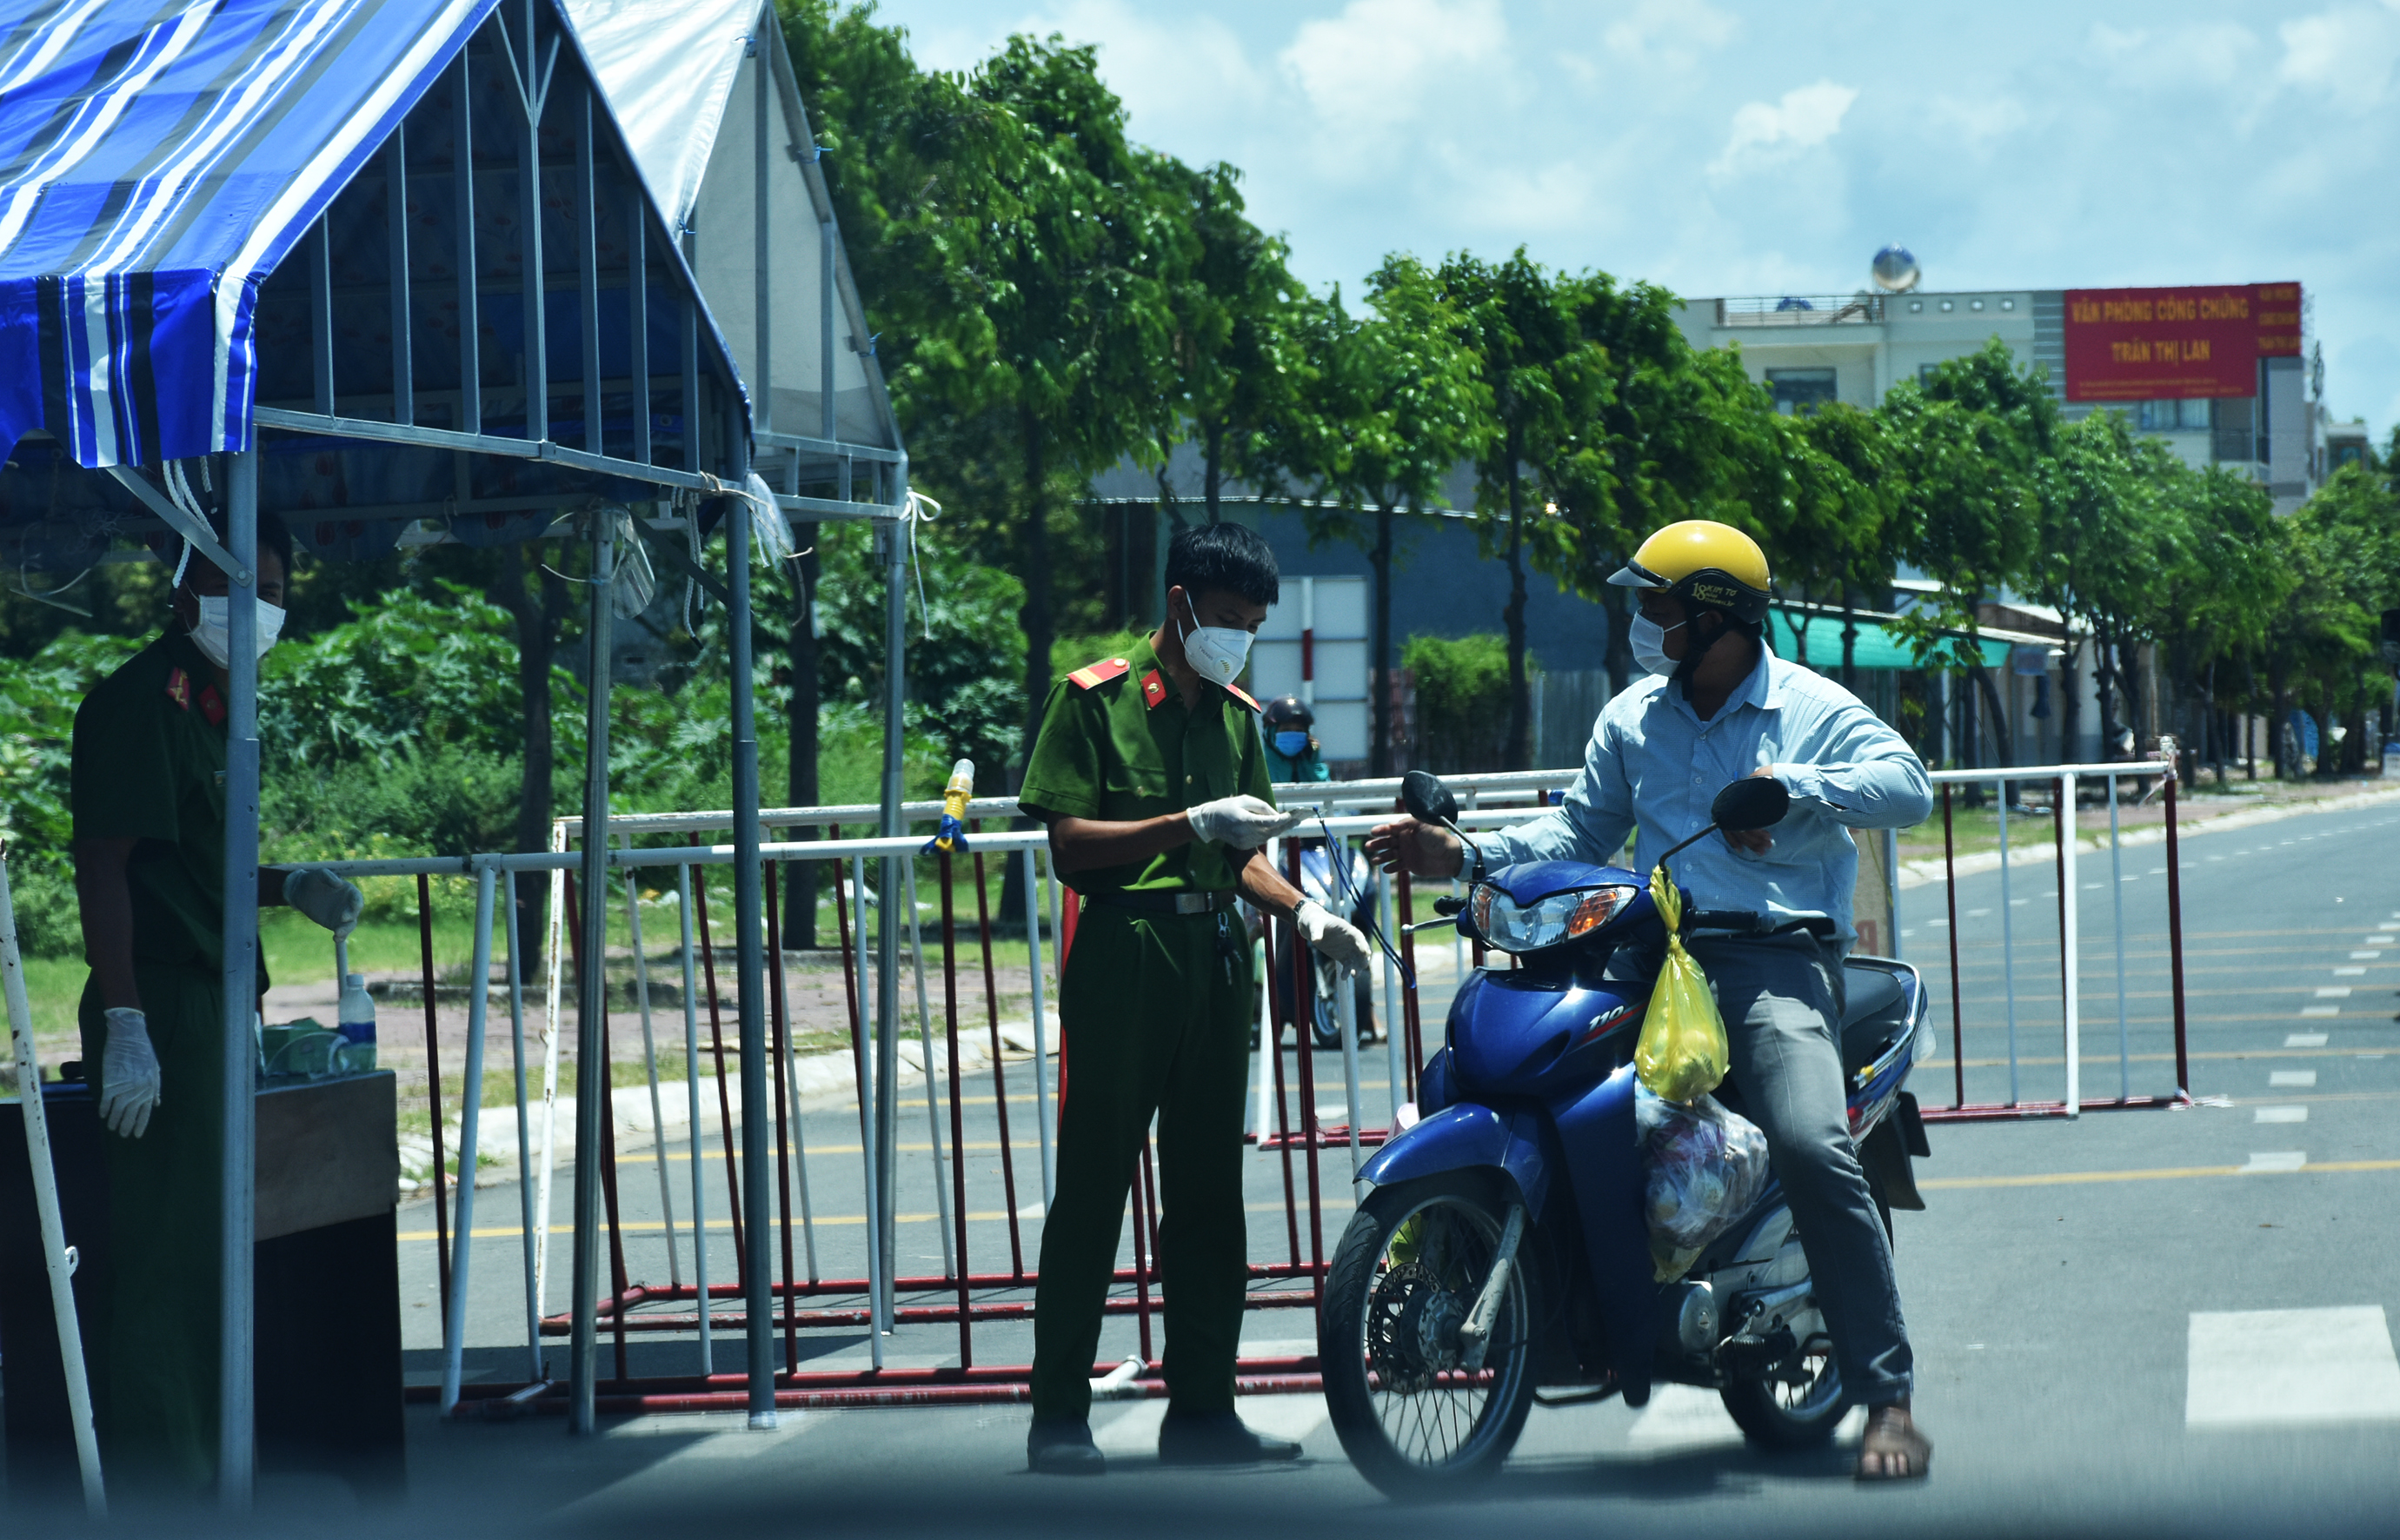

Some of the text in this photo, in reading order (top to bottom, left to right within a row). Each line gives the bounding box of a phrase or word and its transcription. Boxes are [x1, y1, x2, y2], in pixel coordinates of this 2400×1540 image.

[2157, 294, 2197, 321] CÔNG
[2183, 339, 2211, 361] LAN
[1692, 582, 1705, 600] 18
[1589, 1006, 1625, 1031] 110
